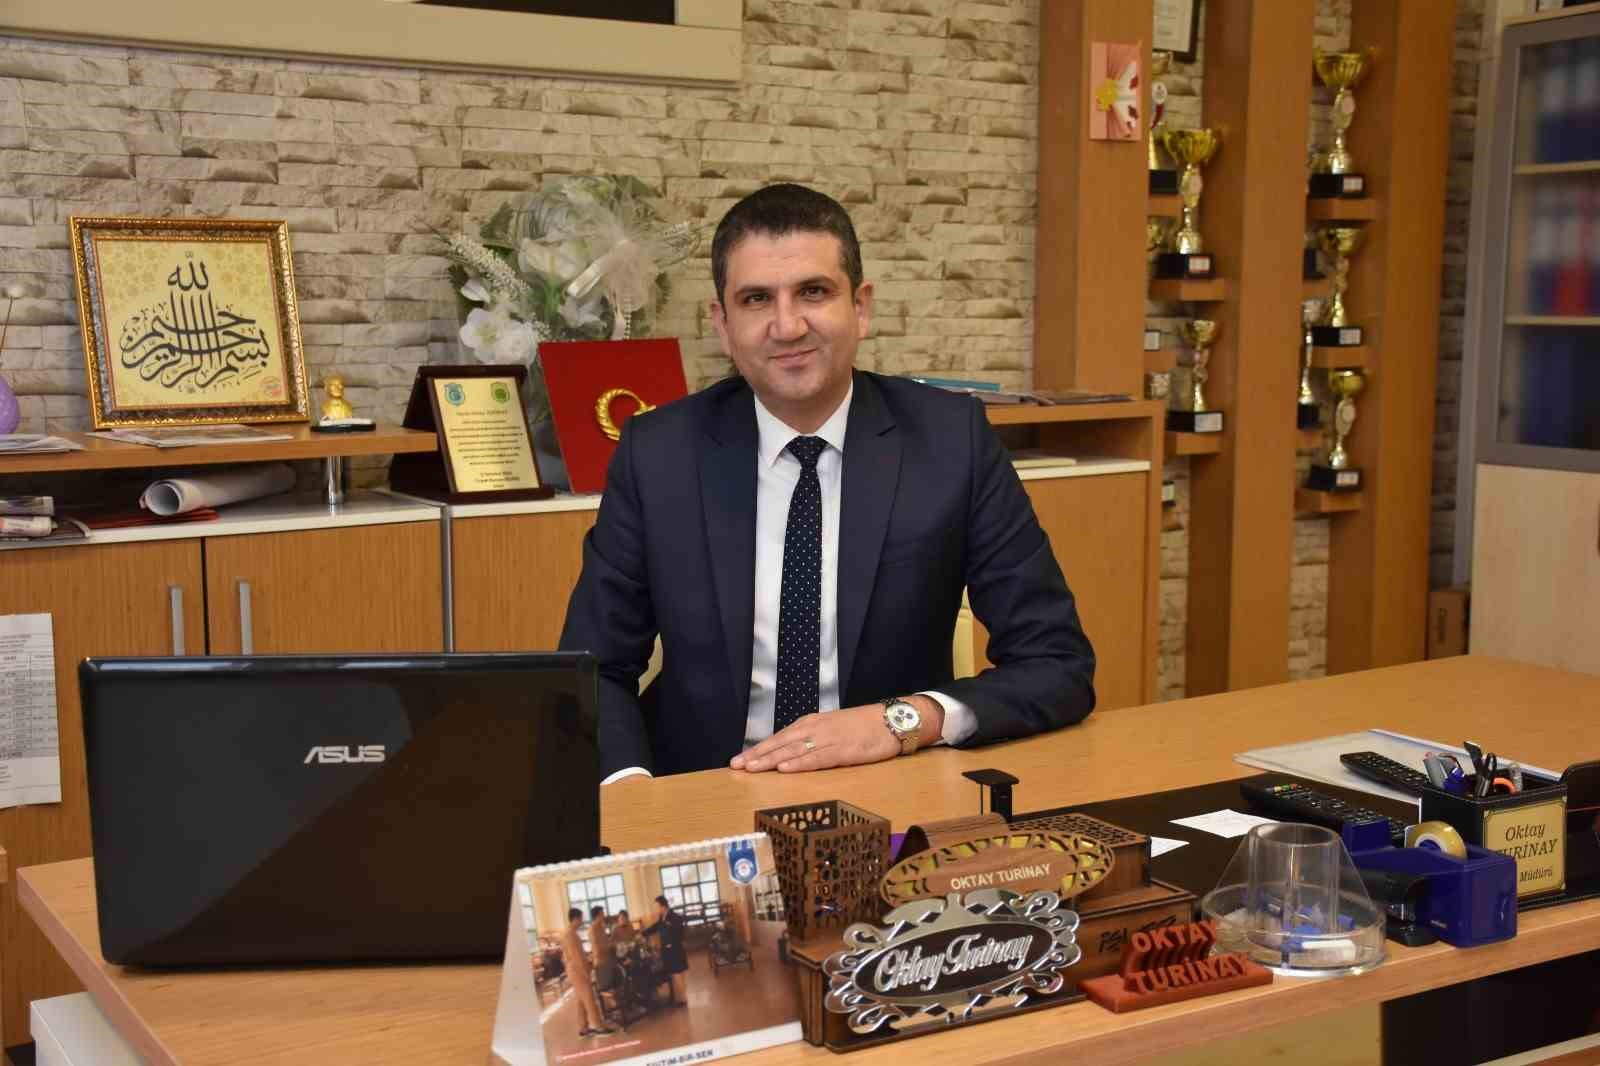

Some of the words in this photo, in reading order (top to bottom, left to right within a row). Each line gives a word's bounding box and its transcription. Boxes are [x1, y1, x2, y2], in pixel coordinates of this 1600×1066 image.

[304, 745, 385, 764] ASUS
[1505, 824, 1546, 841] Oktay
[1497, 838, 1558, 859] URİNAY
[950, 872, 994, 890] OKTAY
[1131, 920, 1216, 953] OKTAY
[874, 945, 946, 992] Oktay
[1126, 952, 1248, 994] TURİNAY
